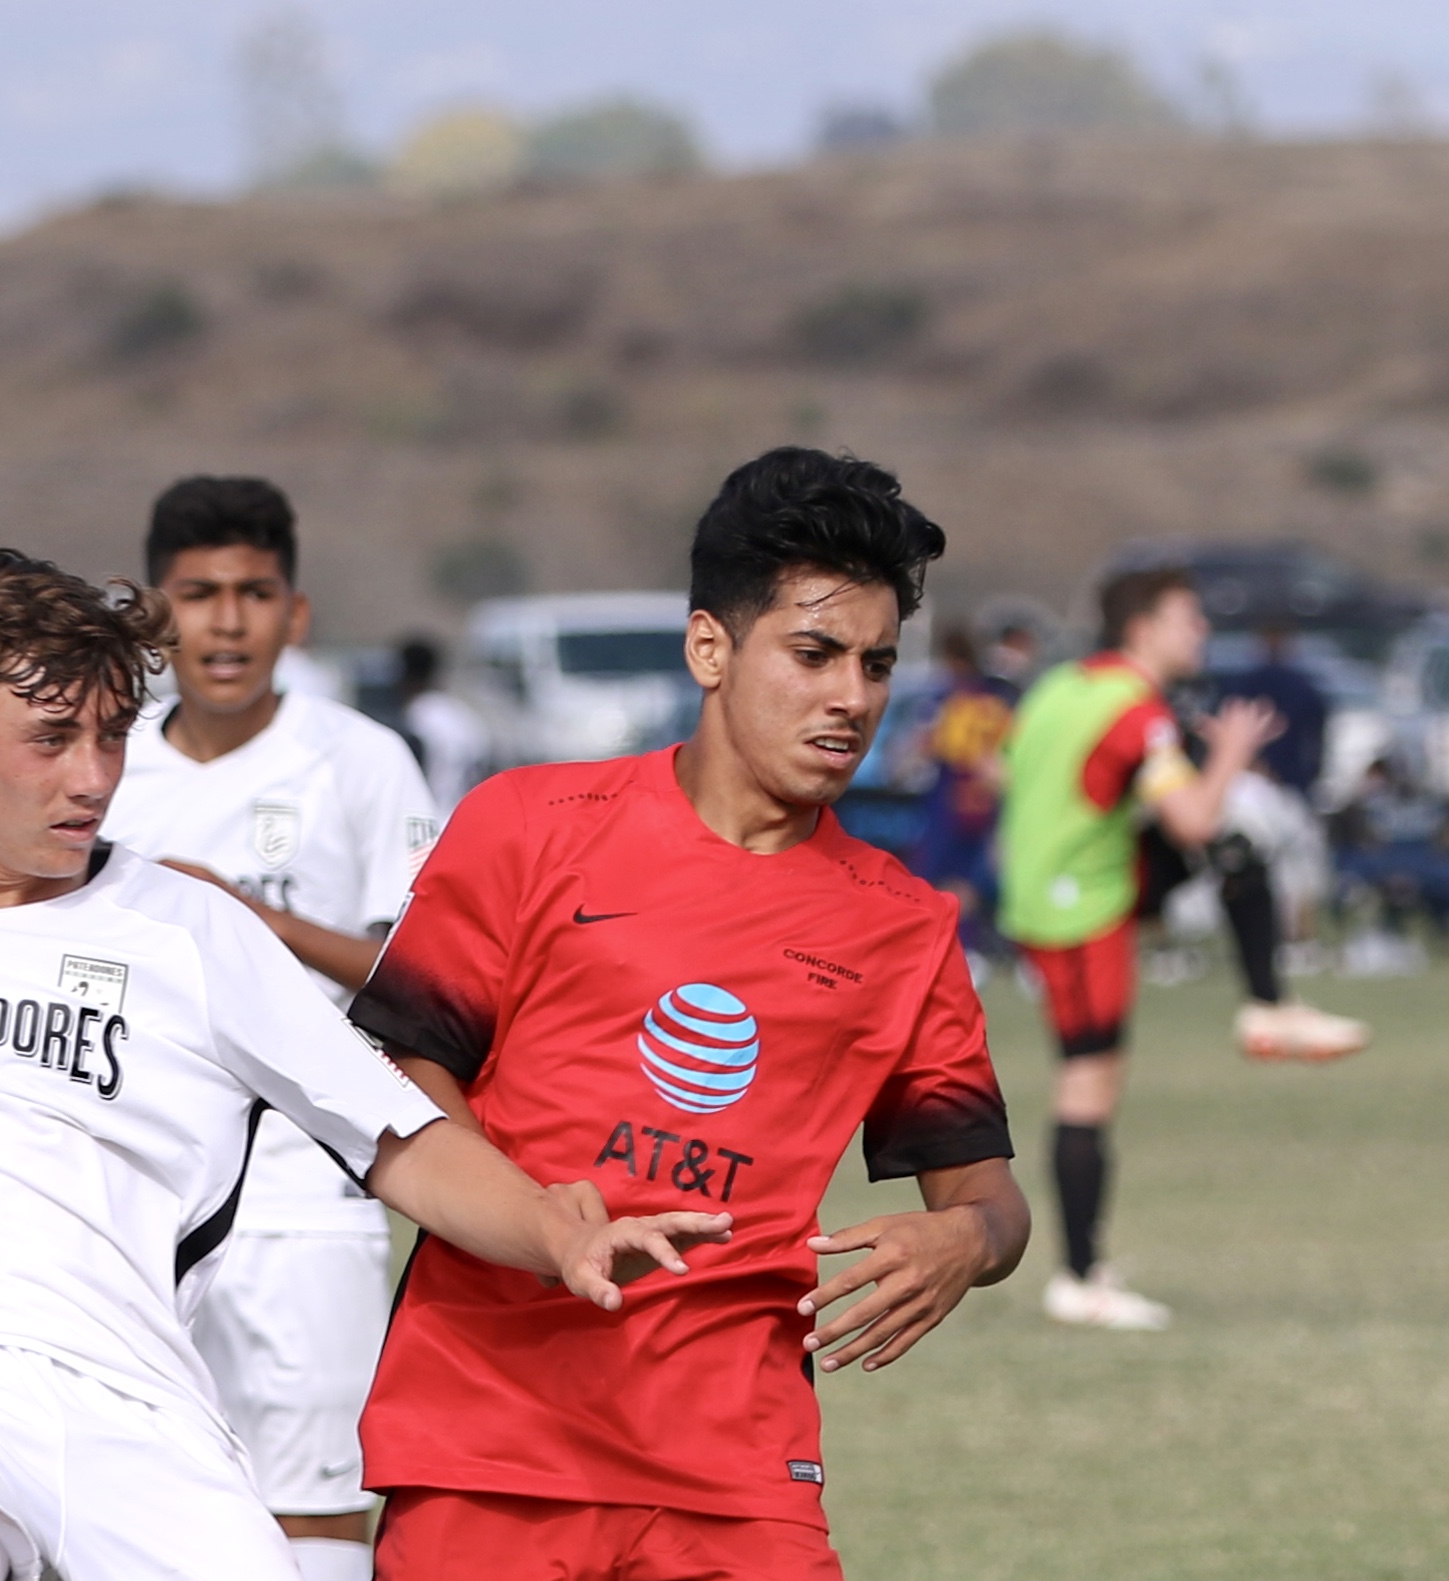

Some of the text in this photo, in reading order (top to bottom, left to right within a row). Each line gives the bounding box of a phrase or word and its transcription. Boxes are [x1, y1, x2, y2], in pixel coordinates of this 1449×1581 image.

[783, 948, 863, 984] CONCORDE
[807, 972, 838, 990] FIRE
[594, 1120, 754, 1203] AT&T
